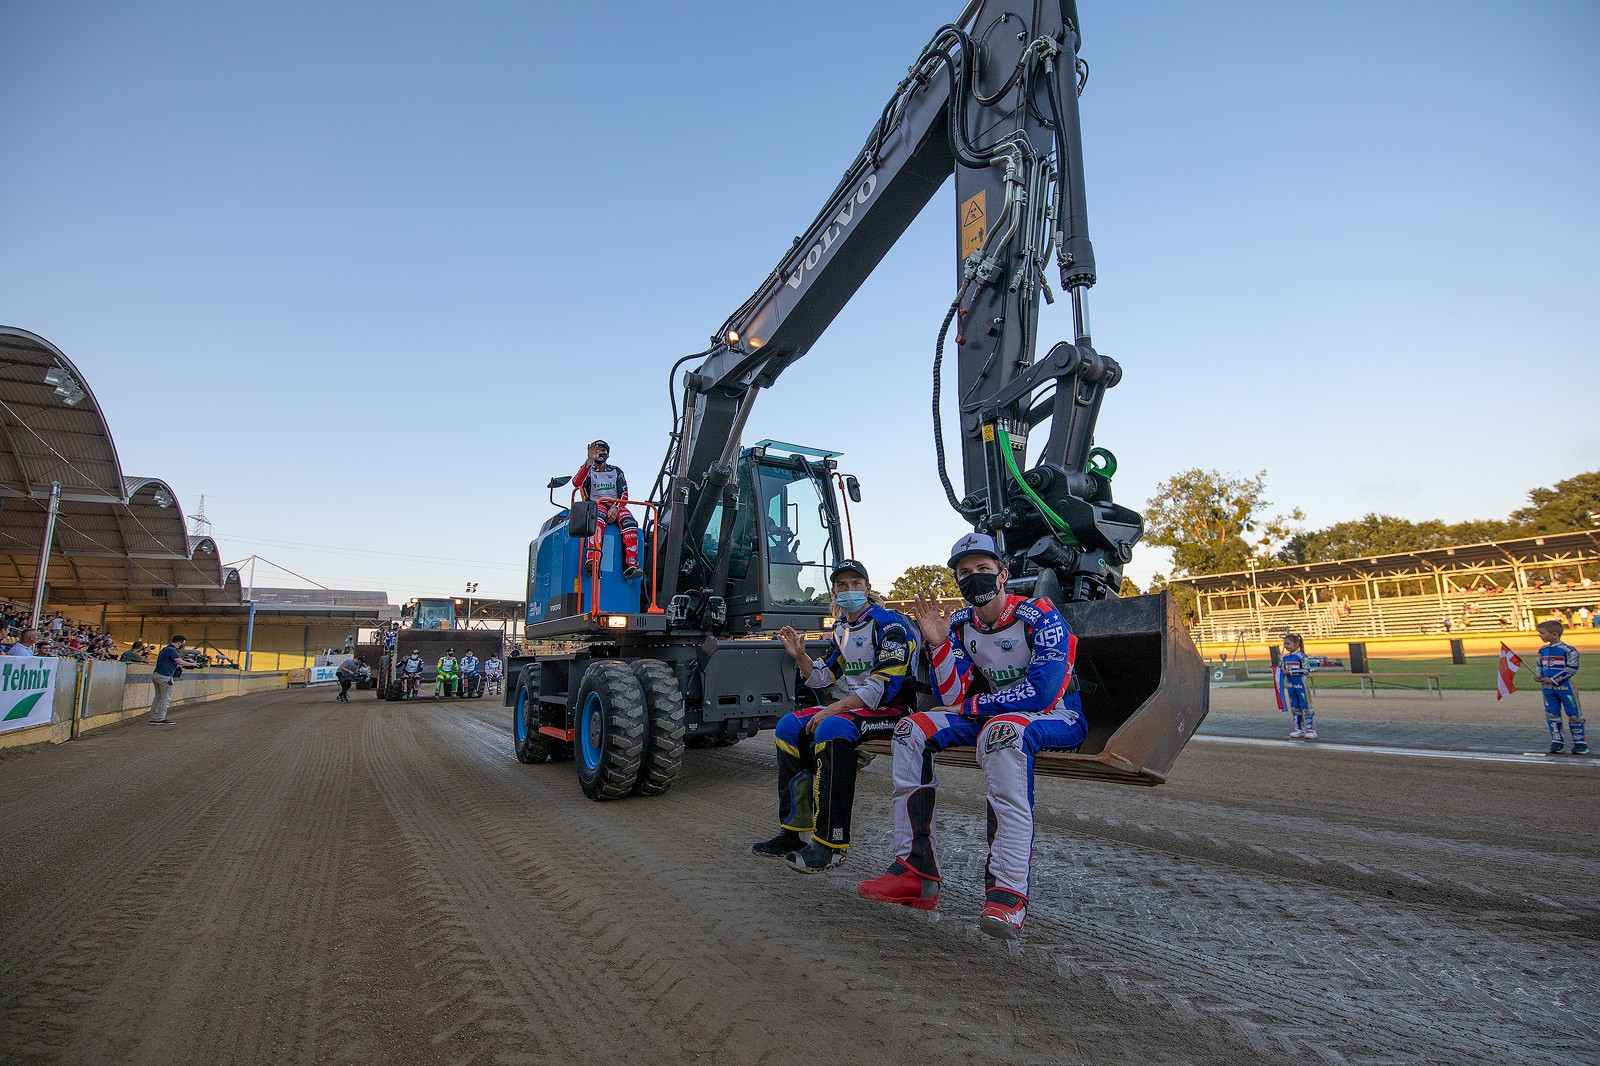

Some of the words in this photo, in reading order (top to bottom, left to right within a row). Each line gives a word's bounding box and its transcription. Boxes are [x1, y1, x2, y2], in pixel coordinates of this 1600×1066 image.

[786, 174, 877, 290] VOLVO
[970, 640, 977, 654] 8
[2, 659, 52, 692] Tehnix
[978, 686, 1036, 705] SHOCKS
